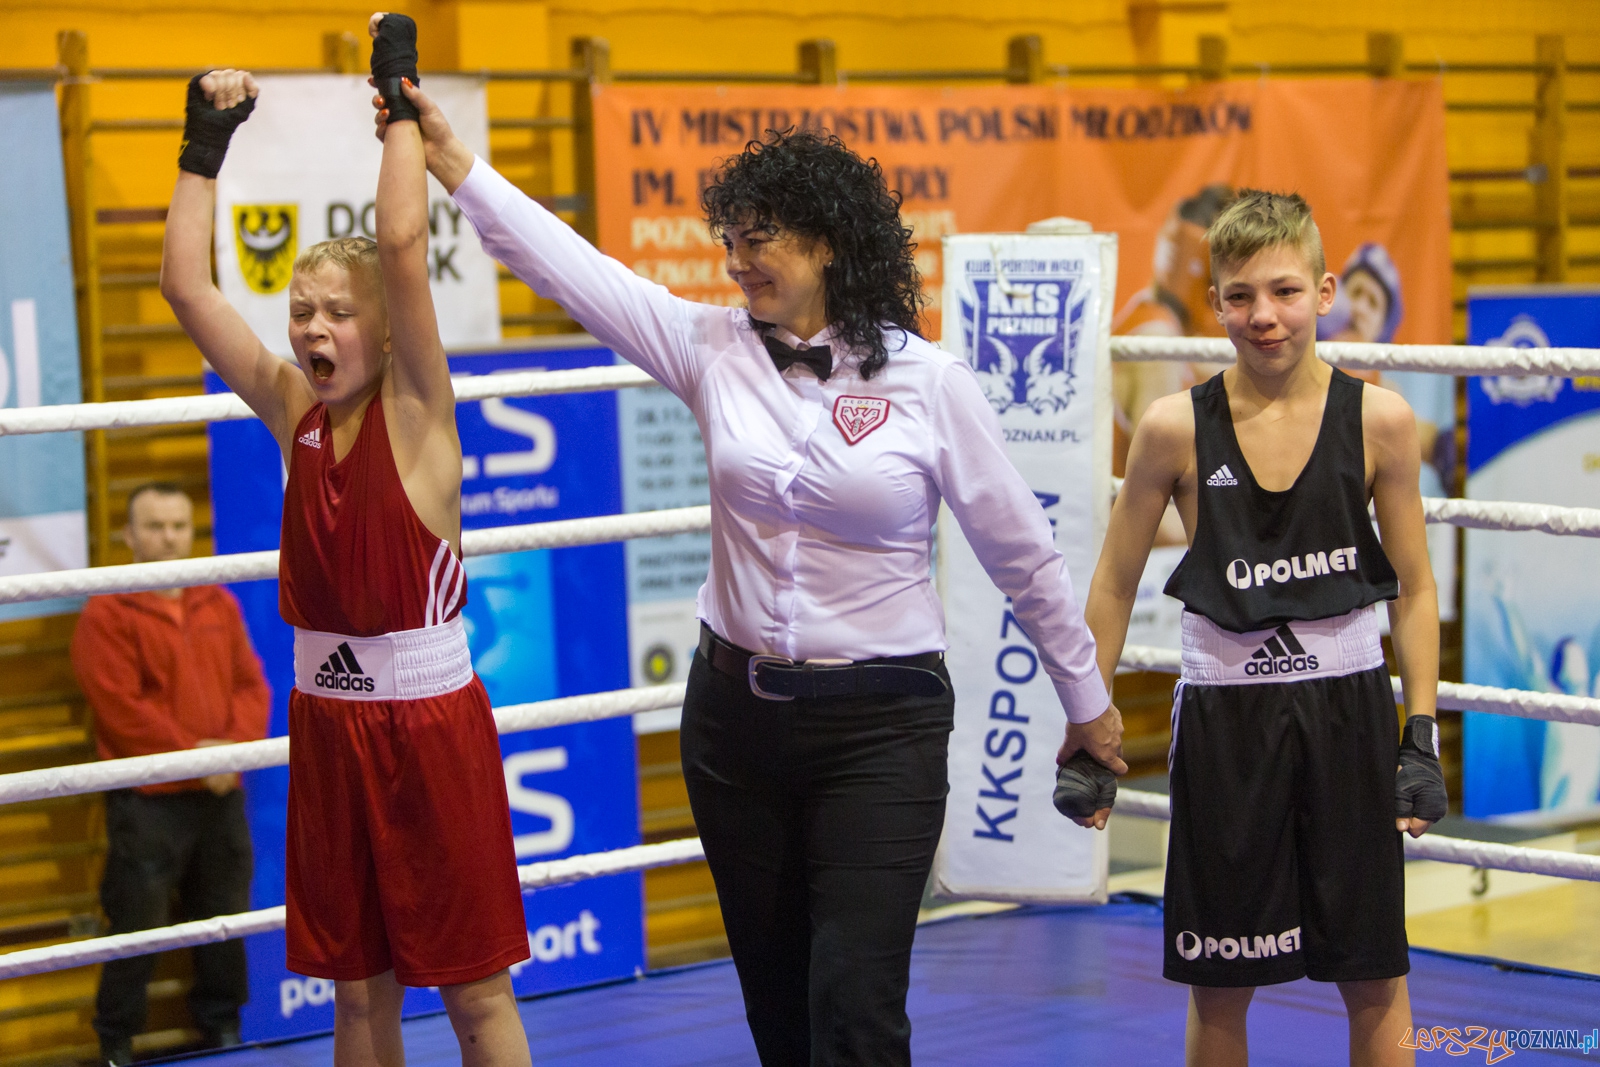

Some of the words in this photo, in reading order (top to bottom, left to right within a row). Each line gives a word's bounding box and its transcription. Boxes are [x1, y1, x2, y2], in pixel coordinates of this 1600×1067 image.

[631, 108, 665, 146] IV
[987, 282, 1060, 315] KKS
[298, 436, 322, 449] adidas
[1206, 477, 1239, 487] adidas
[1253, 546, 1358, 587] POLMET
[1244, 653, 1320, 676] adidas
[314, 671, 375, 692] adidas
[1203, 926, 1302, 960] POLMET
